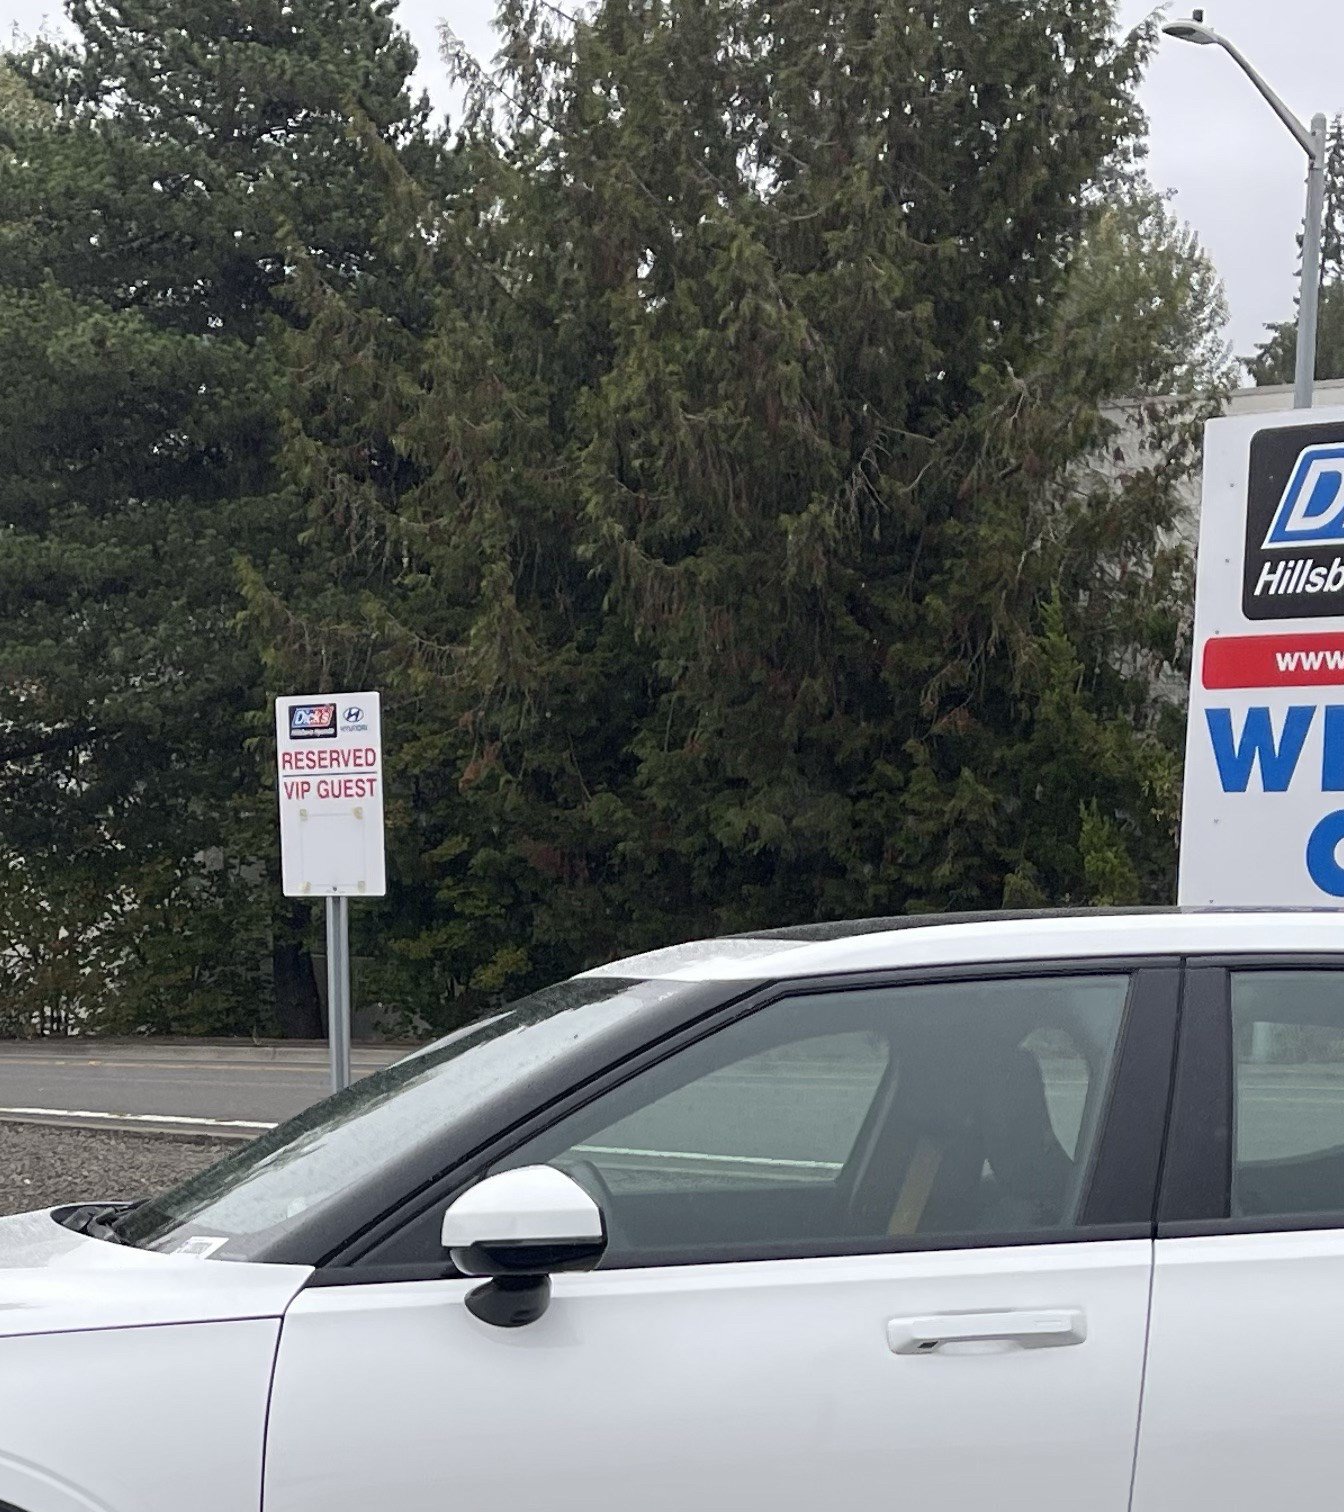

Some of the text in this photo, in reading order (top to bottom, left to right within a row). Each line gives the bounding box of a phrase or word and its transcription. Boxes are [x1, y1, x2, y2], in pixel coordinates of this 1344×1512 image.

[281, 748, 376, 770] RESERVED
[283, 778, 377, 800] VIP GUEST
